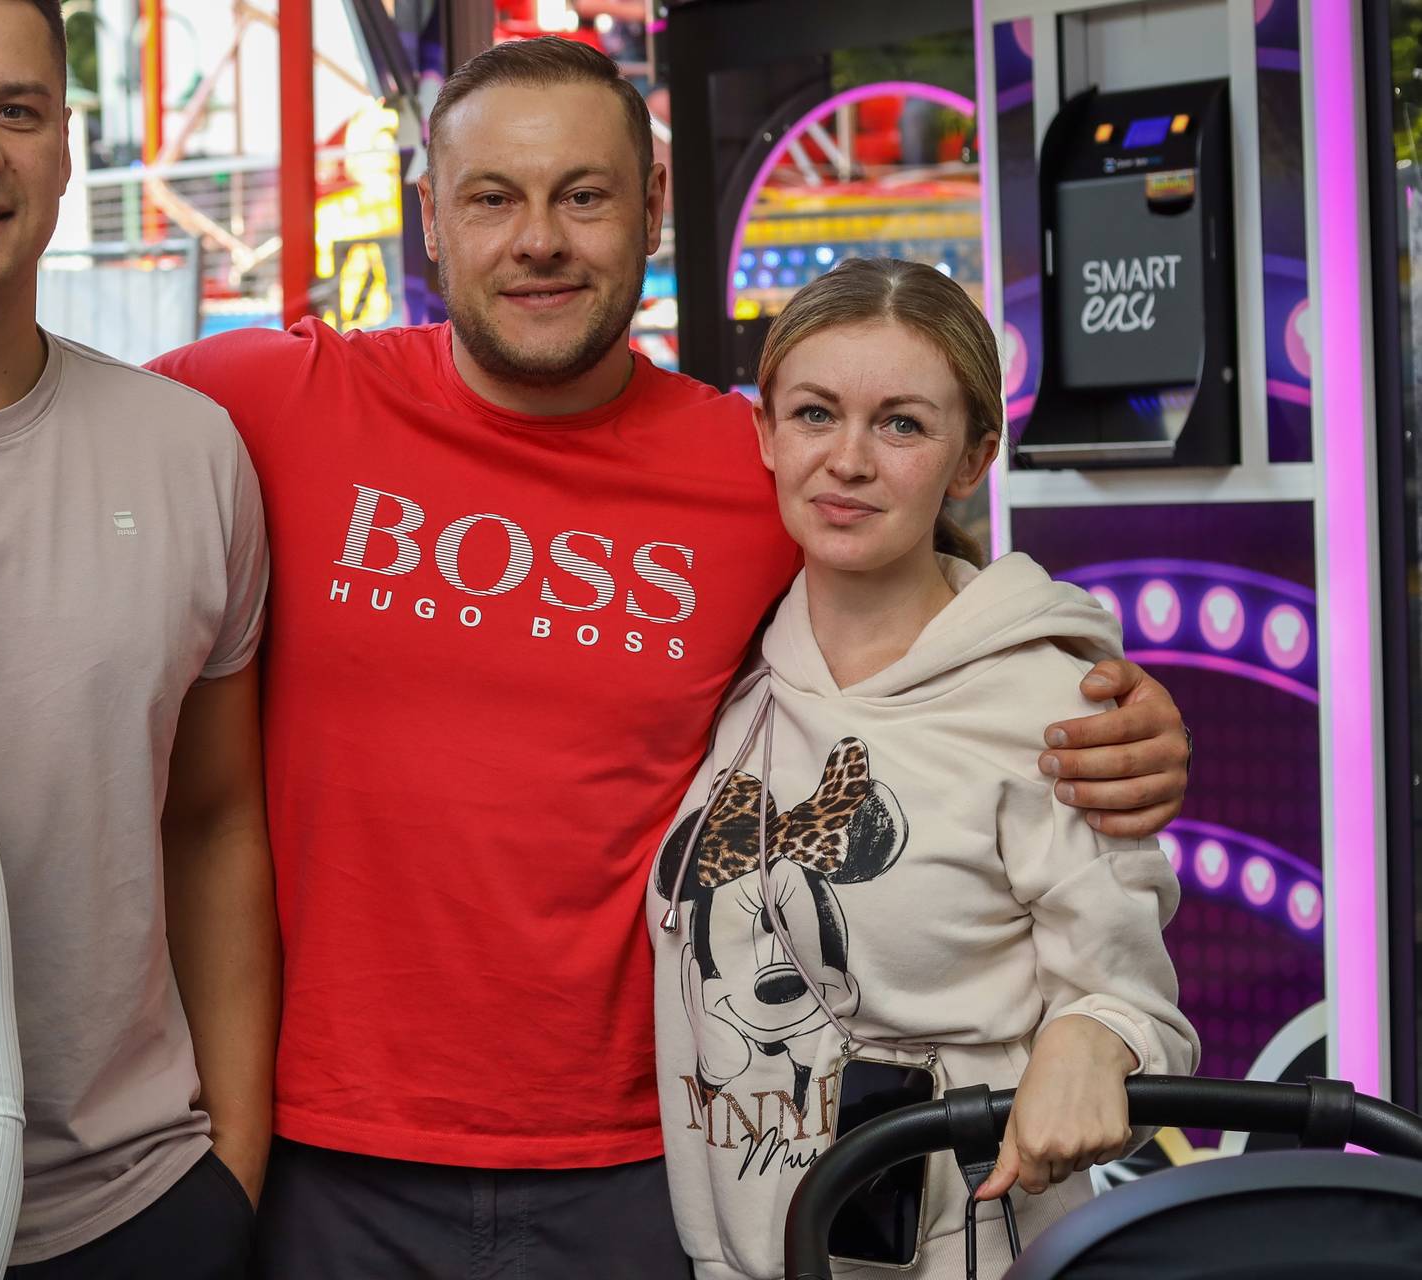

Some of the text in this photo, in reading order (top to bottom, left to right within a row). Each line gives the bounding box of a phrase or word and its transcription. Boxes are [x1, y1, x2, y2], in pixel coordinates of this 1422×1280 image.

[1082, 255, 1182, 294] SMART
[333, 483, 697, 624] BOSS
[329, 579, 685, 660] HUGO BOSS
